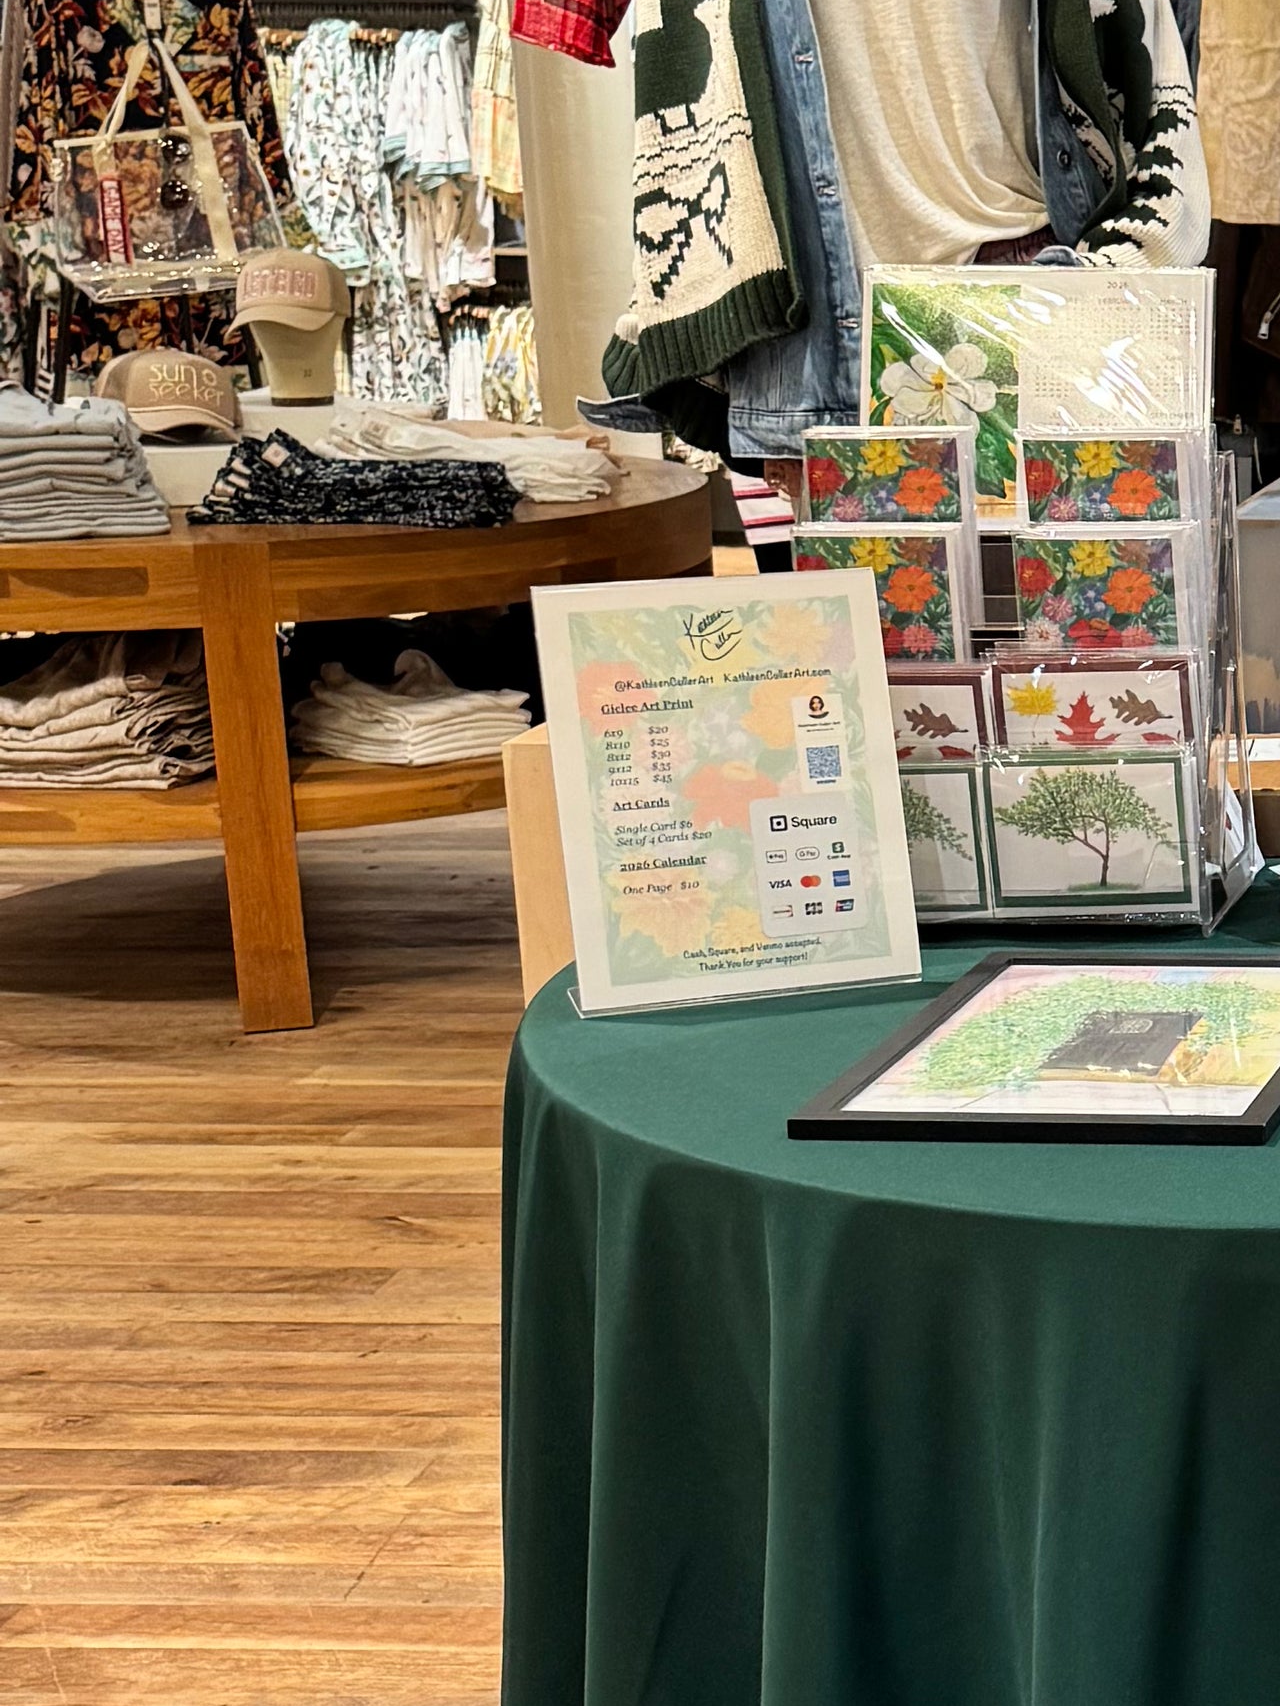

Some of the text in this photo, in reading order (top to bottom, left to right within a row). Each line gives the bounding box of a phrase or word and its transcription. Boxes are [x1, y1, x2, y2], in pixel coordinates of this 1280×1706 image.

[106, 229, 125, 254] DAY
[149, 363, 197, 384] sun
[149, 383, 224, 406] seeker
[640, 701, 661, 713] Art
[662, 698, 694, 711] Print
[648, 725, 669, 735] $20
[650, 738, 670, 747] $25
[651, 750, 671, 760] $30
[651, 762, 672, 772] $35
[653, 774, 673, 784] $45
[613, 797, 671, 812] Art Cards
[614, 820, 693, 836] Single Card $6
[791, 815, 837, 829] Square
[616, 837, 633, 847] Set
[635, 835, 647, 847] of
[648, 836, 656, 845] 4
[657, 832, 689, 844] Cards
[620, 855, 708, 873] 2026 Calendar
[623, 881, 700, 896] One Page $10
[769, 880, 793, 889] VISA
[708, 946, 739, 958] Square,
[740, 944, 755, 953] and
[756, 942, 784, 952] Venmo
[699, 951, 808, 972] Thank You for your support!
